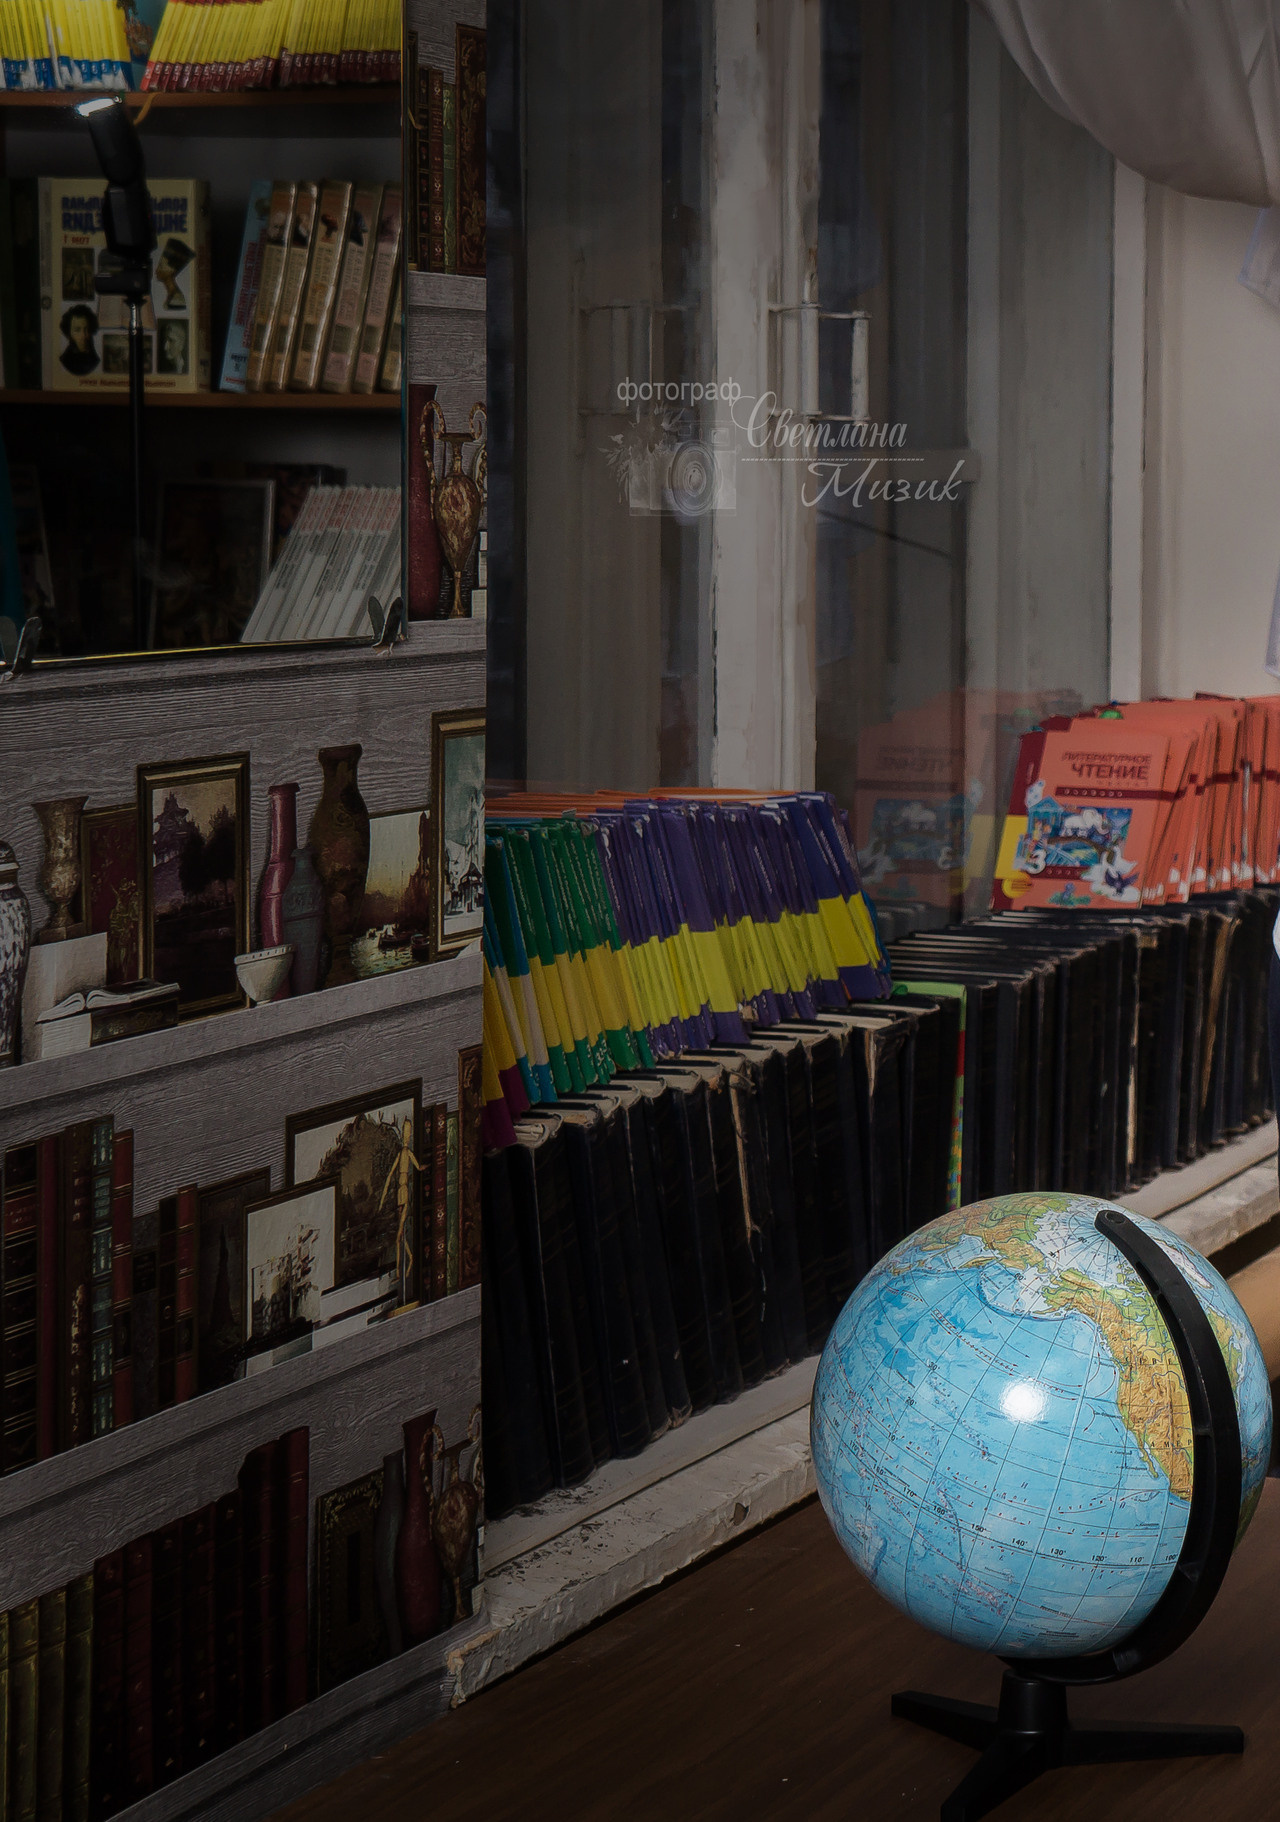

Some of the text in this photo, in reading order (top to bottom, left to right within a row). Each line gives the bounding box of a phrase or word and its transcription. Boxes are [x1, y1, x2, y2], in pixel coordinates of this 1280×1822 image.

[1061, 751, 1152, 763] ЛИТЕРАТУРНОЕ
[1070, 763, 1149, 780] ЧТЕНИЕ
[1026, 847, 1047, 875] 3
